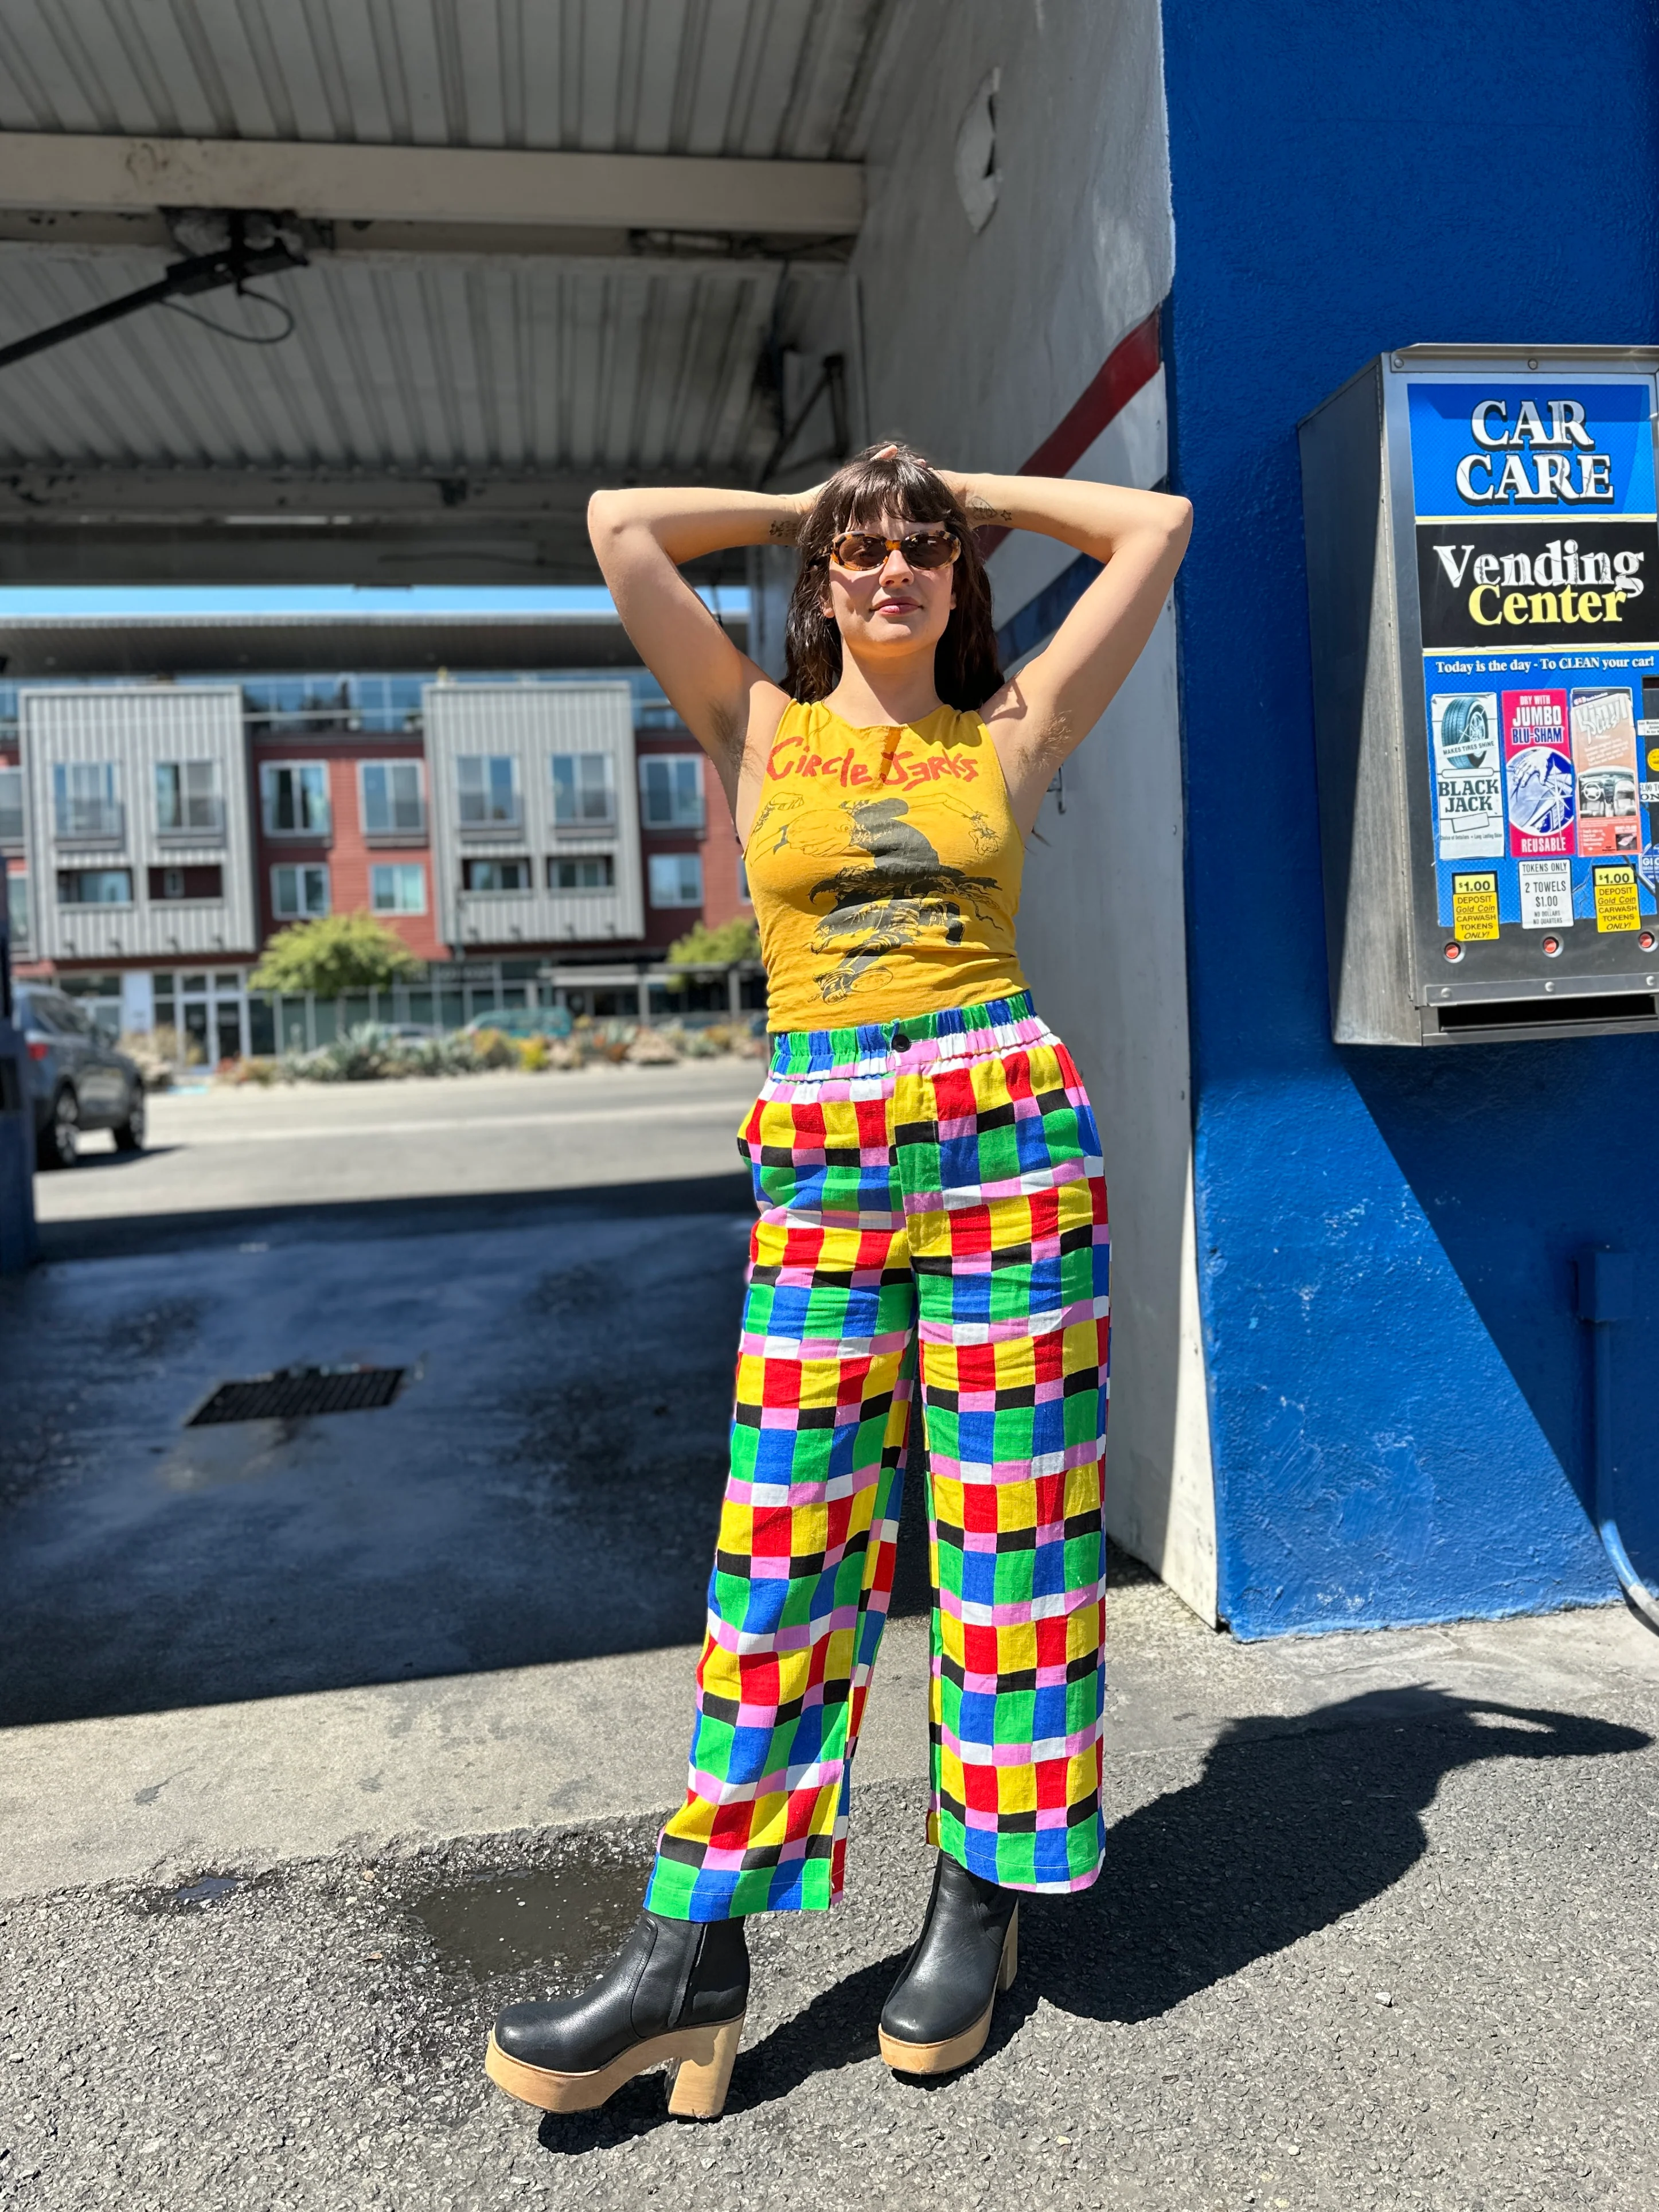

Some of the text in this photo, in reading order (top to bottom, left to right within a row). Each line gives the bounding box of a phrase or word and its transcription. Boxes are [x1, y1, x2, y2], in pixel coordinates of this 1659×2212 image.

[1470, 400, 1595, 450] CAR
[1455, 453, 1614, 504] CARE
[1433, 539, 1645, 598] Vending
[1468, 584, 1627, 625] Center
[1435, 661, 1474, 675] Today
[1475, 660, 1486, 672] is
[1488, 660, 1508, 672] the
[1510, 659, 1532, 673] day
[1539, 658, 1557, 670] To
[1559, 657, 1600, 669] CLEAN
[1602, 658, 1630, 670] your
[1632, 656, 1654, 668] car!
[1520, 695, 1551, 705] DRY WITH
[1512, 705, 1562, 727] JUMBO
[1512, 727, 1563, 744] BLU-SHAM
[1443, 740, 1495, 755] MAKES TIRES SHINE
[1438, 779, 1499, 797] BLACK
[1445, 795, 1493, 813] JACK
[1521, 837, 1566, 853] REUSABLE
[1523, 862, 1567, 872] TOKENS ONLY
[1599, 873, 1630, 884] $1.00
[1459, 880, 1490, 892] $1.00
[1525, 880, 1567, 893] 2 TOWELS
[1599, 887, 1633, 896] DEPOSIT
[1457, 895, 1492, 904] DEPOSIT
[1535, 895, 1558, 907] $1.00
[1598, 896, 1636, 905] Gold Coin
[1456, 904, 1496, 914] Gold Coin
[1598, 905, 1637, 914] CARWASH
[1456, 914, 1496, 922] CARWASH
[1602, 914, 1635, 922] TOKENS
[1460, 923, 1493, 931] TOKENS
[1606, 922, 1631, 930] ONLY!
[1463, 931, 1490, 939] ONLY!
